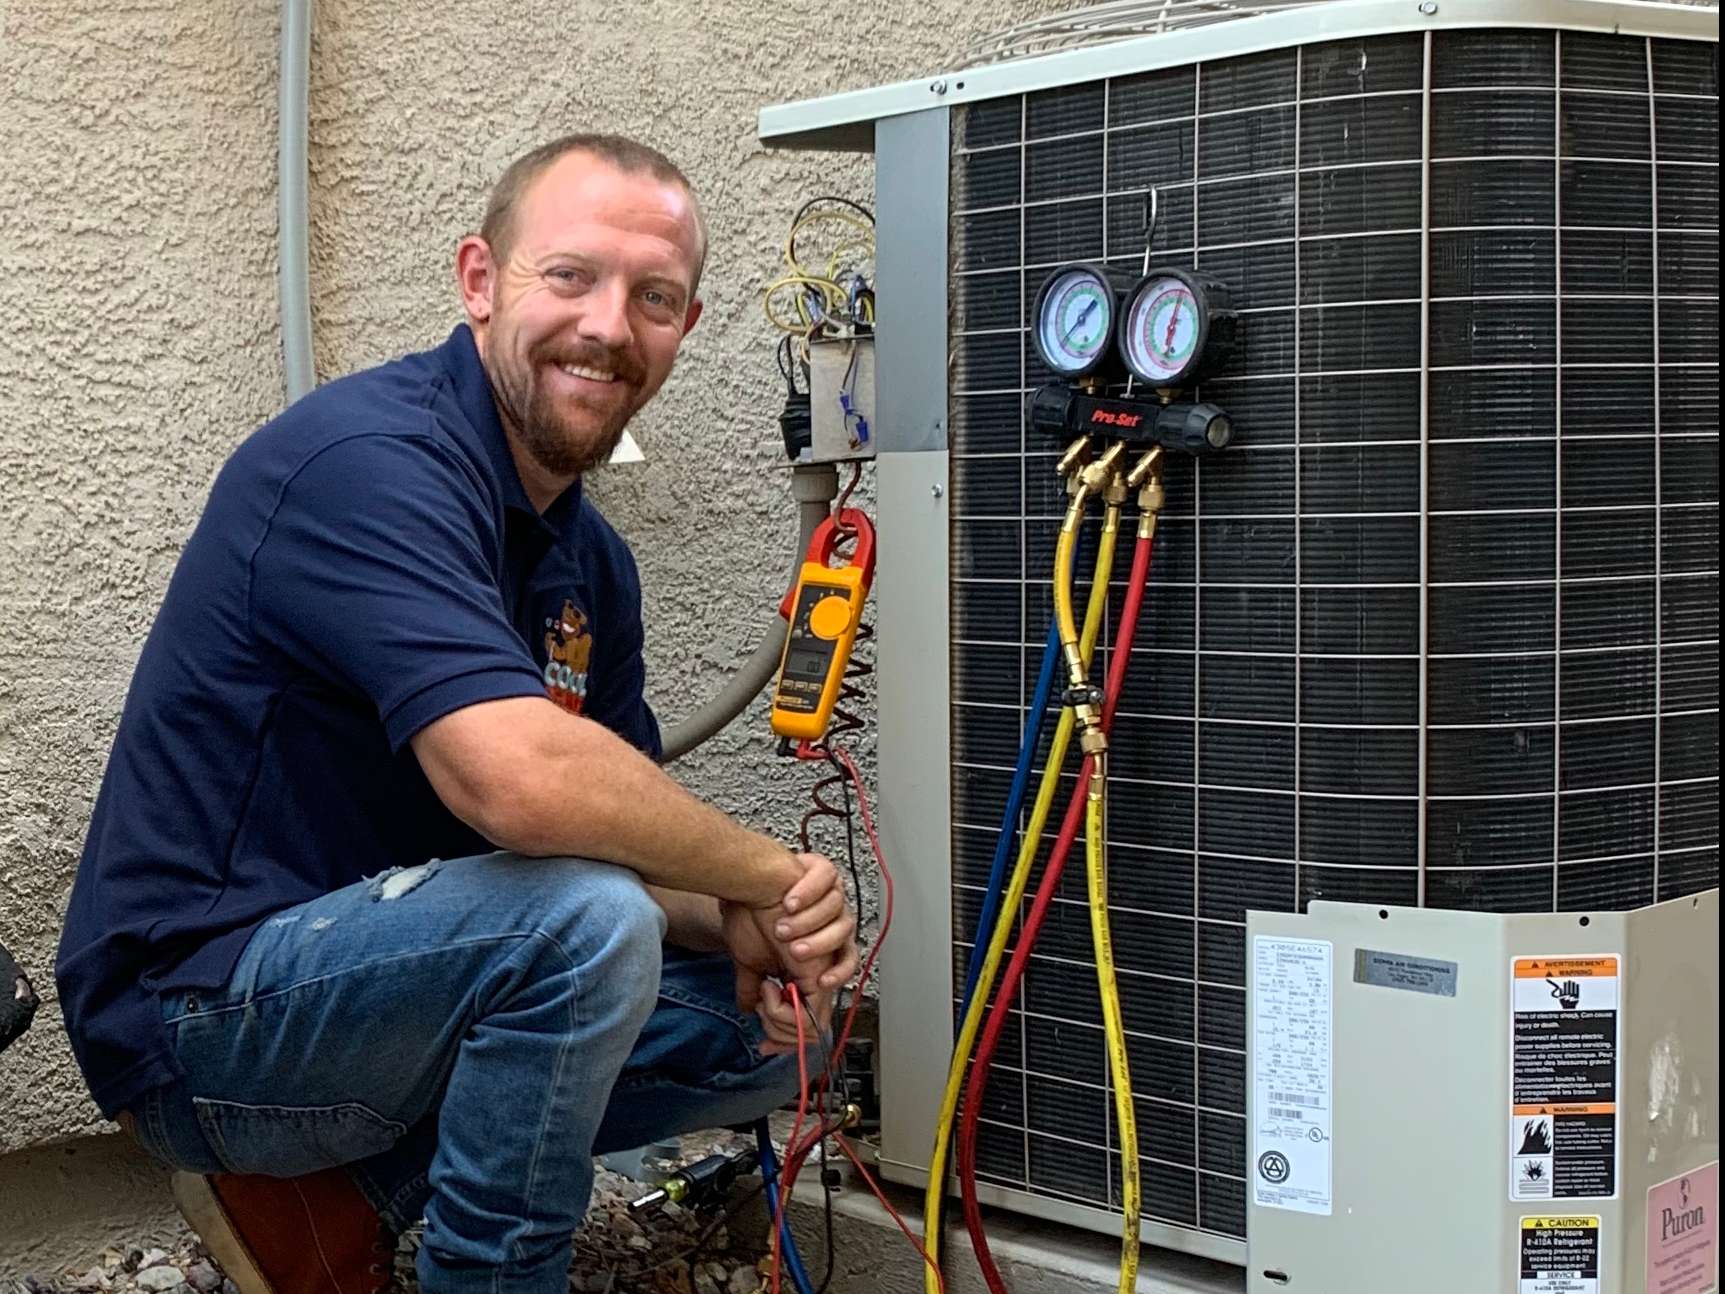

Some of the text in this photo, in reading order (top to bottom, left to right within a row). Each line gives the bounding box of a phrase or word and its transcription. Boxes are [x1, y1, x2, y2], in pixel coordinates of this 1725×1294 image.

[1091, 409, 1138, 427] Pro-Set
[1662, 1206, 1704, 1241] Puron
[1554, 1238, 1592, 1247] Refrigerant
